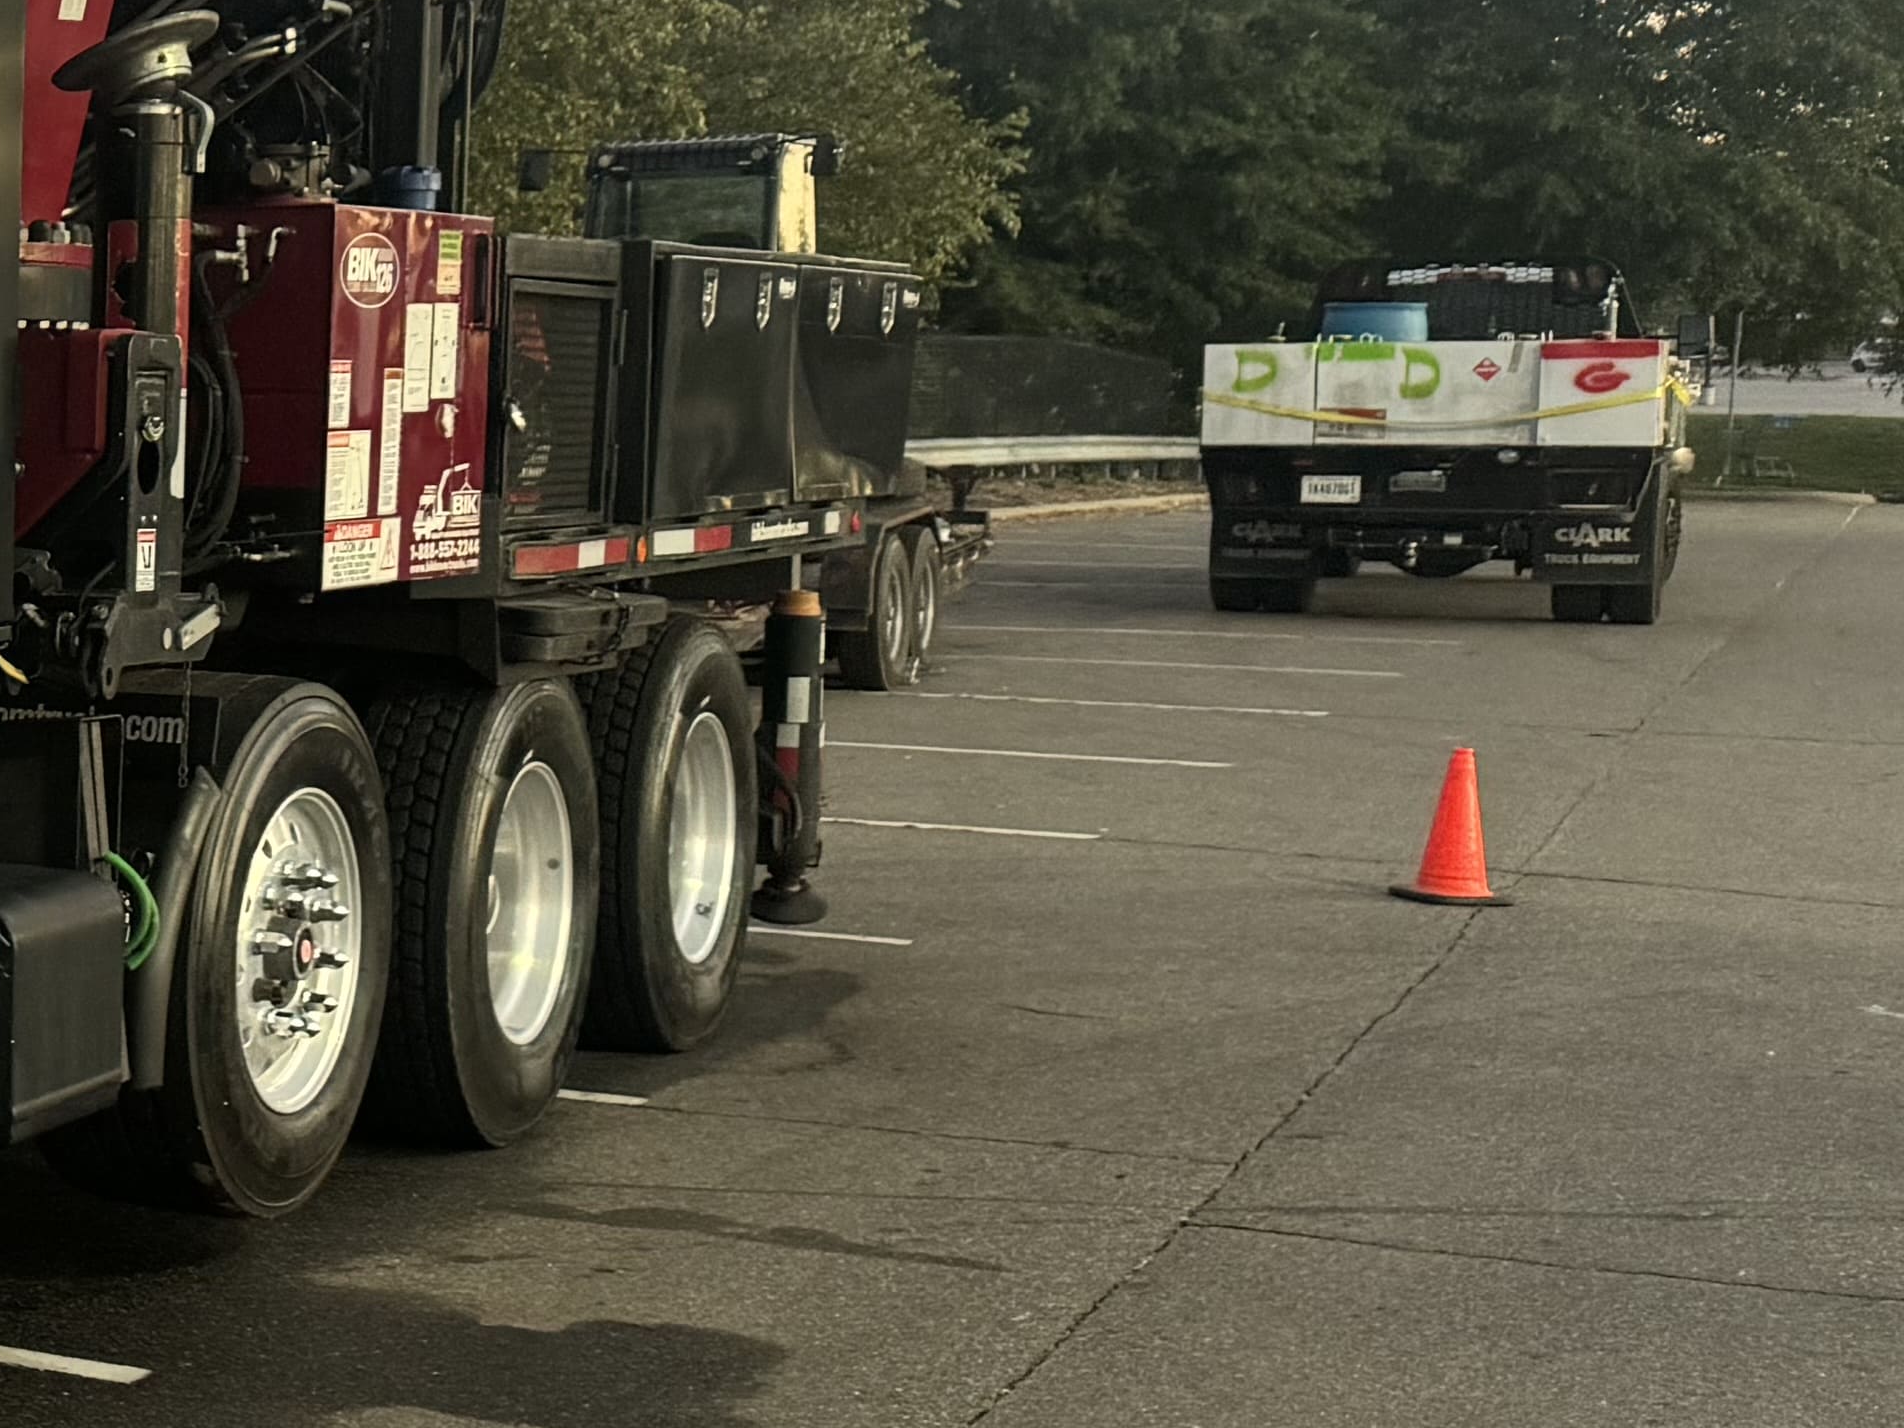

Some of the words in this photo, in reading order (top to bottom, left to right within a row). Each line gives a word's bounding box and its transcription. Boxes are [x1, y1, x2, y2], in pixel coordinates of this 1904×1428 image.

[347, 247, 379, 282] BIK
[452, 494, 478, 516] BIK
[1554, 522, 1631, 548] CLARK
